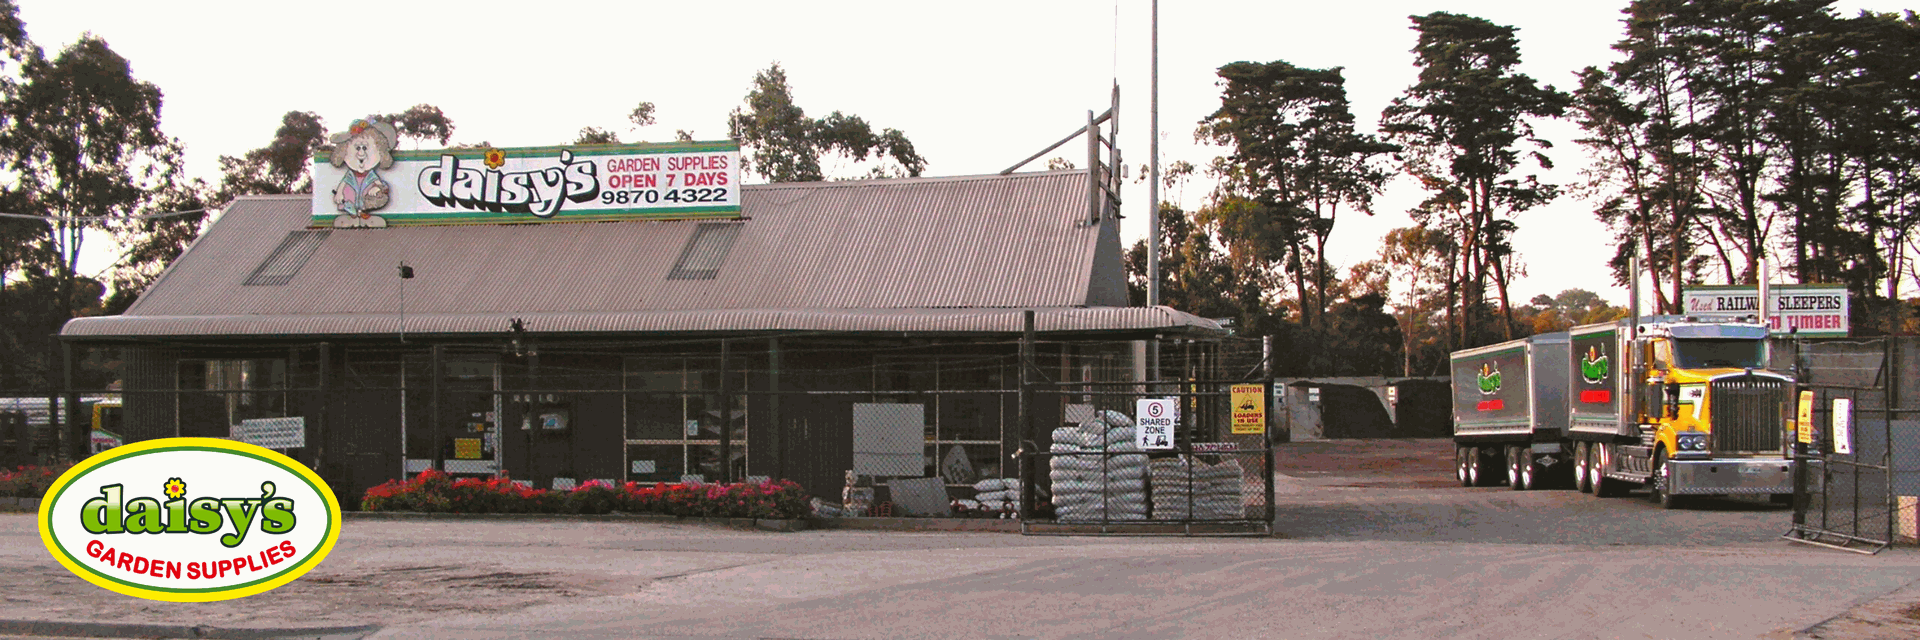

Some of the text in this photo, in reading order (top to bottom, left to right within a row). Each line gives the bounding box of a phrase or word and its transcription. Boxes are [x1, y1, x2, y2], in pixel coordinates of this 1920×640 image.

[607, 155, 728, 173] GARDEN SUPPLIES
[418, 149, 600, 218] daisy's
[608, 172, 728, 189] OPEN 7 DAYS
[601, 188, 728, 205] 9870 4322
[1717, 296, 1770, 311] RAILW
[1778, 296, 1841, 310] SLEEPERS
[1787, 315, 1841, 329] TIMBER
[1152, 405, 1159, 415] 5
[1140, 418, 1171, 426] SHARED
[1145, 426, 1165, 434] ZONE
